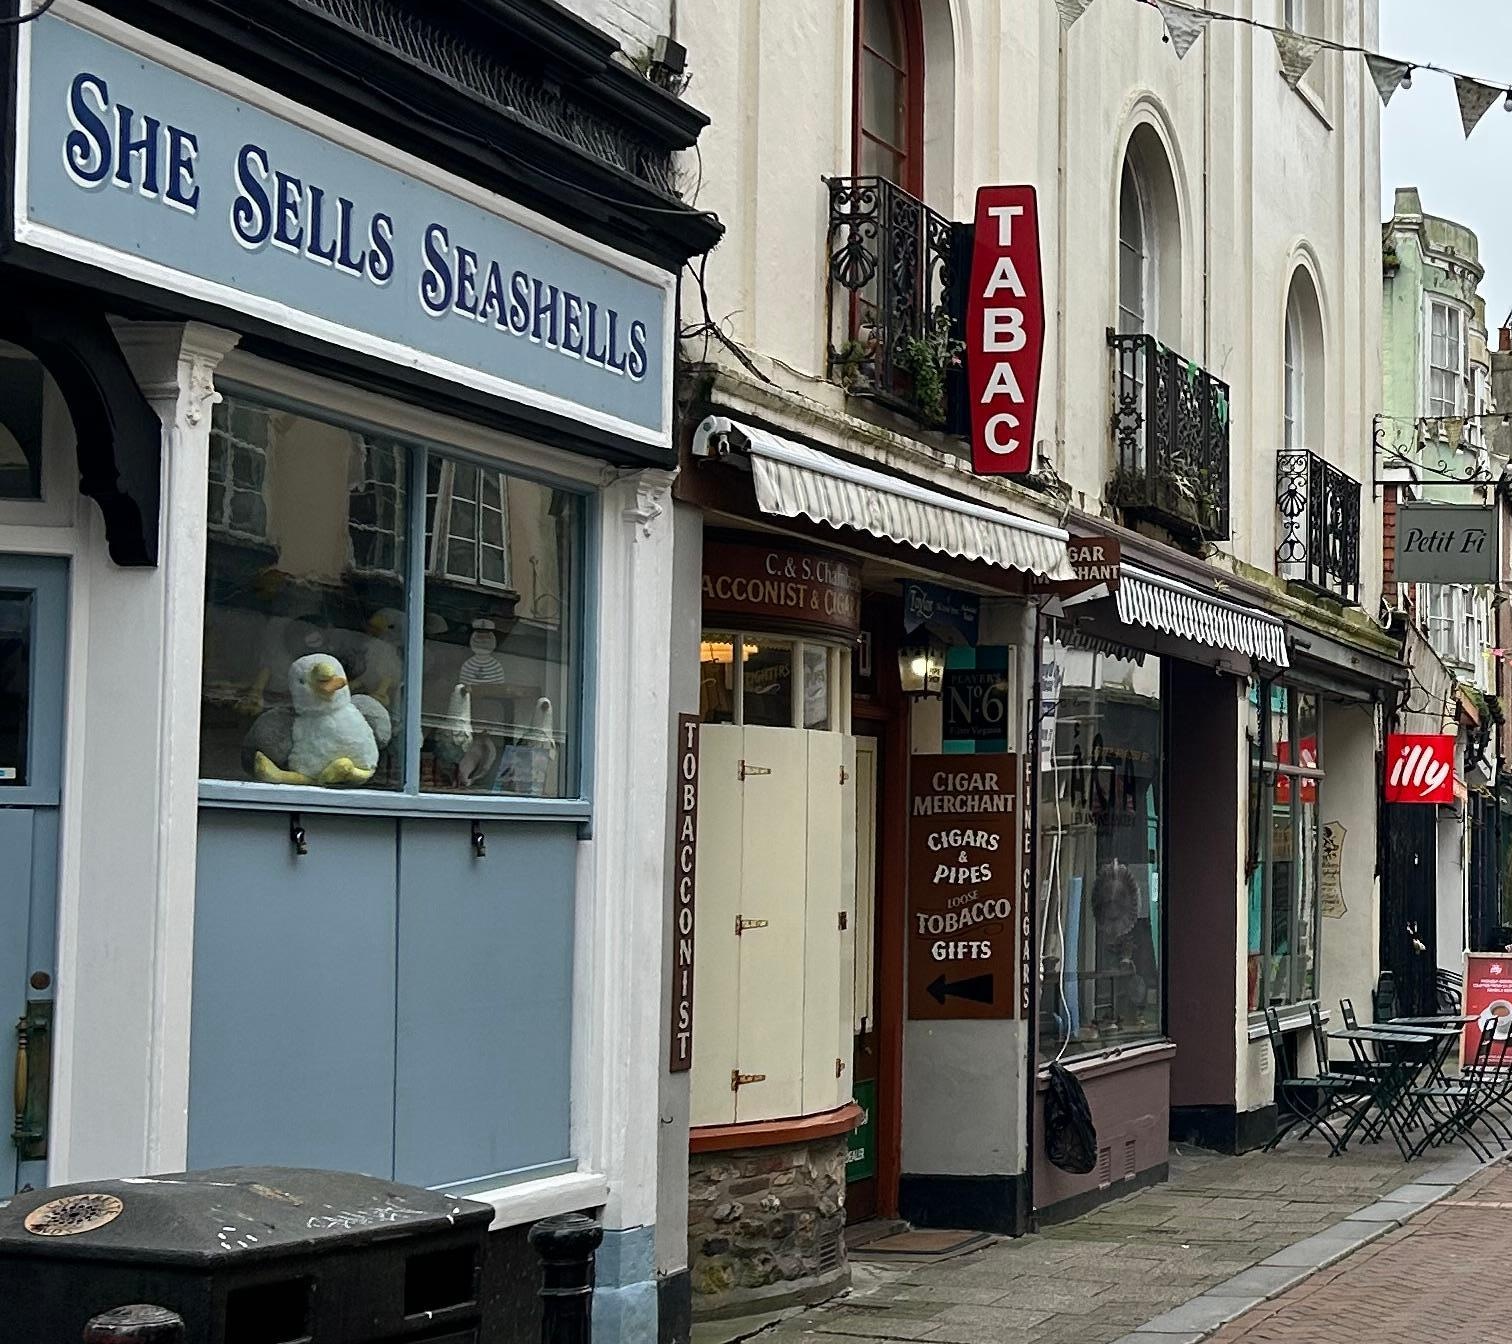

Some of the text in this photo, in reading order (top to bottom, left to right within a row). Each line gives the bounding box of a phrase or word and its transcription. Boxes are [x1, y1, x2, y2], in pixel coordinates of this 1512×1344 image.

[981, 205, 1027, 454] TABAC
[1403, 527, 1487, 553] Petit Fi
[783, 556, 796, 579] &
[810, 590, 820, 610] &
[932, 770, 1000, 792] CIGAR
[1389, 744, 1450, 797] illy
[913, 793, 1016, 817] MERCHANT
[927, 829, 1000, 852] CIGARS
[957, 850, 968, 863] &
[932, 863, 993, 885] PIPES
[1022, 761, 1032, 1010] FINE CIGARS
[676, 721, 697, 1060] TOBACCONIST
[946, 890, 980, 909] LOOSE
[915, 897, 1012, 936] TOBACCO
[931, 940, 993, 961] GIFTS
